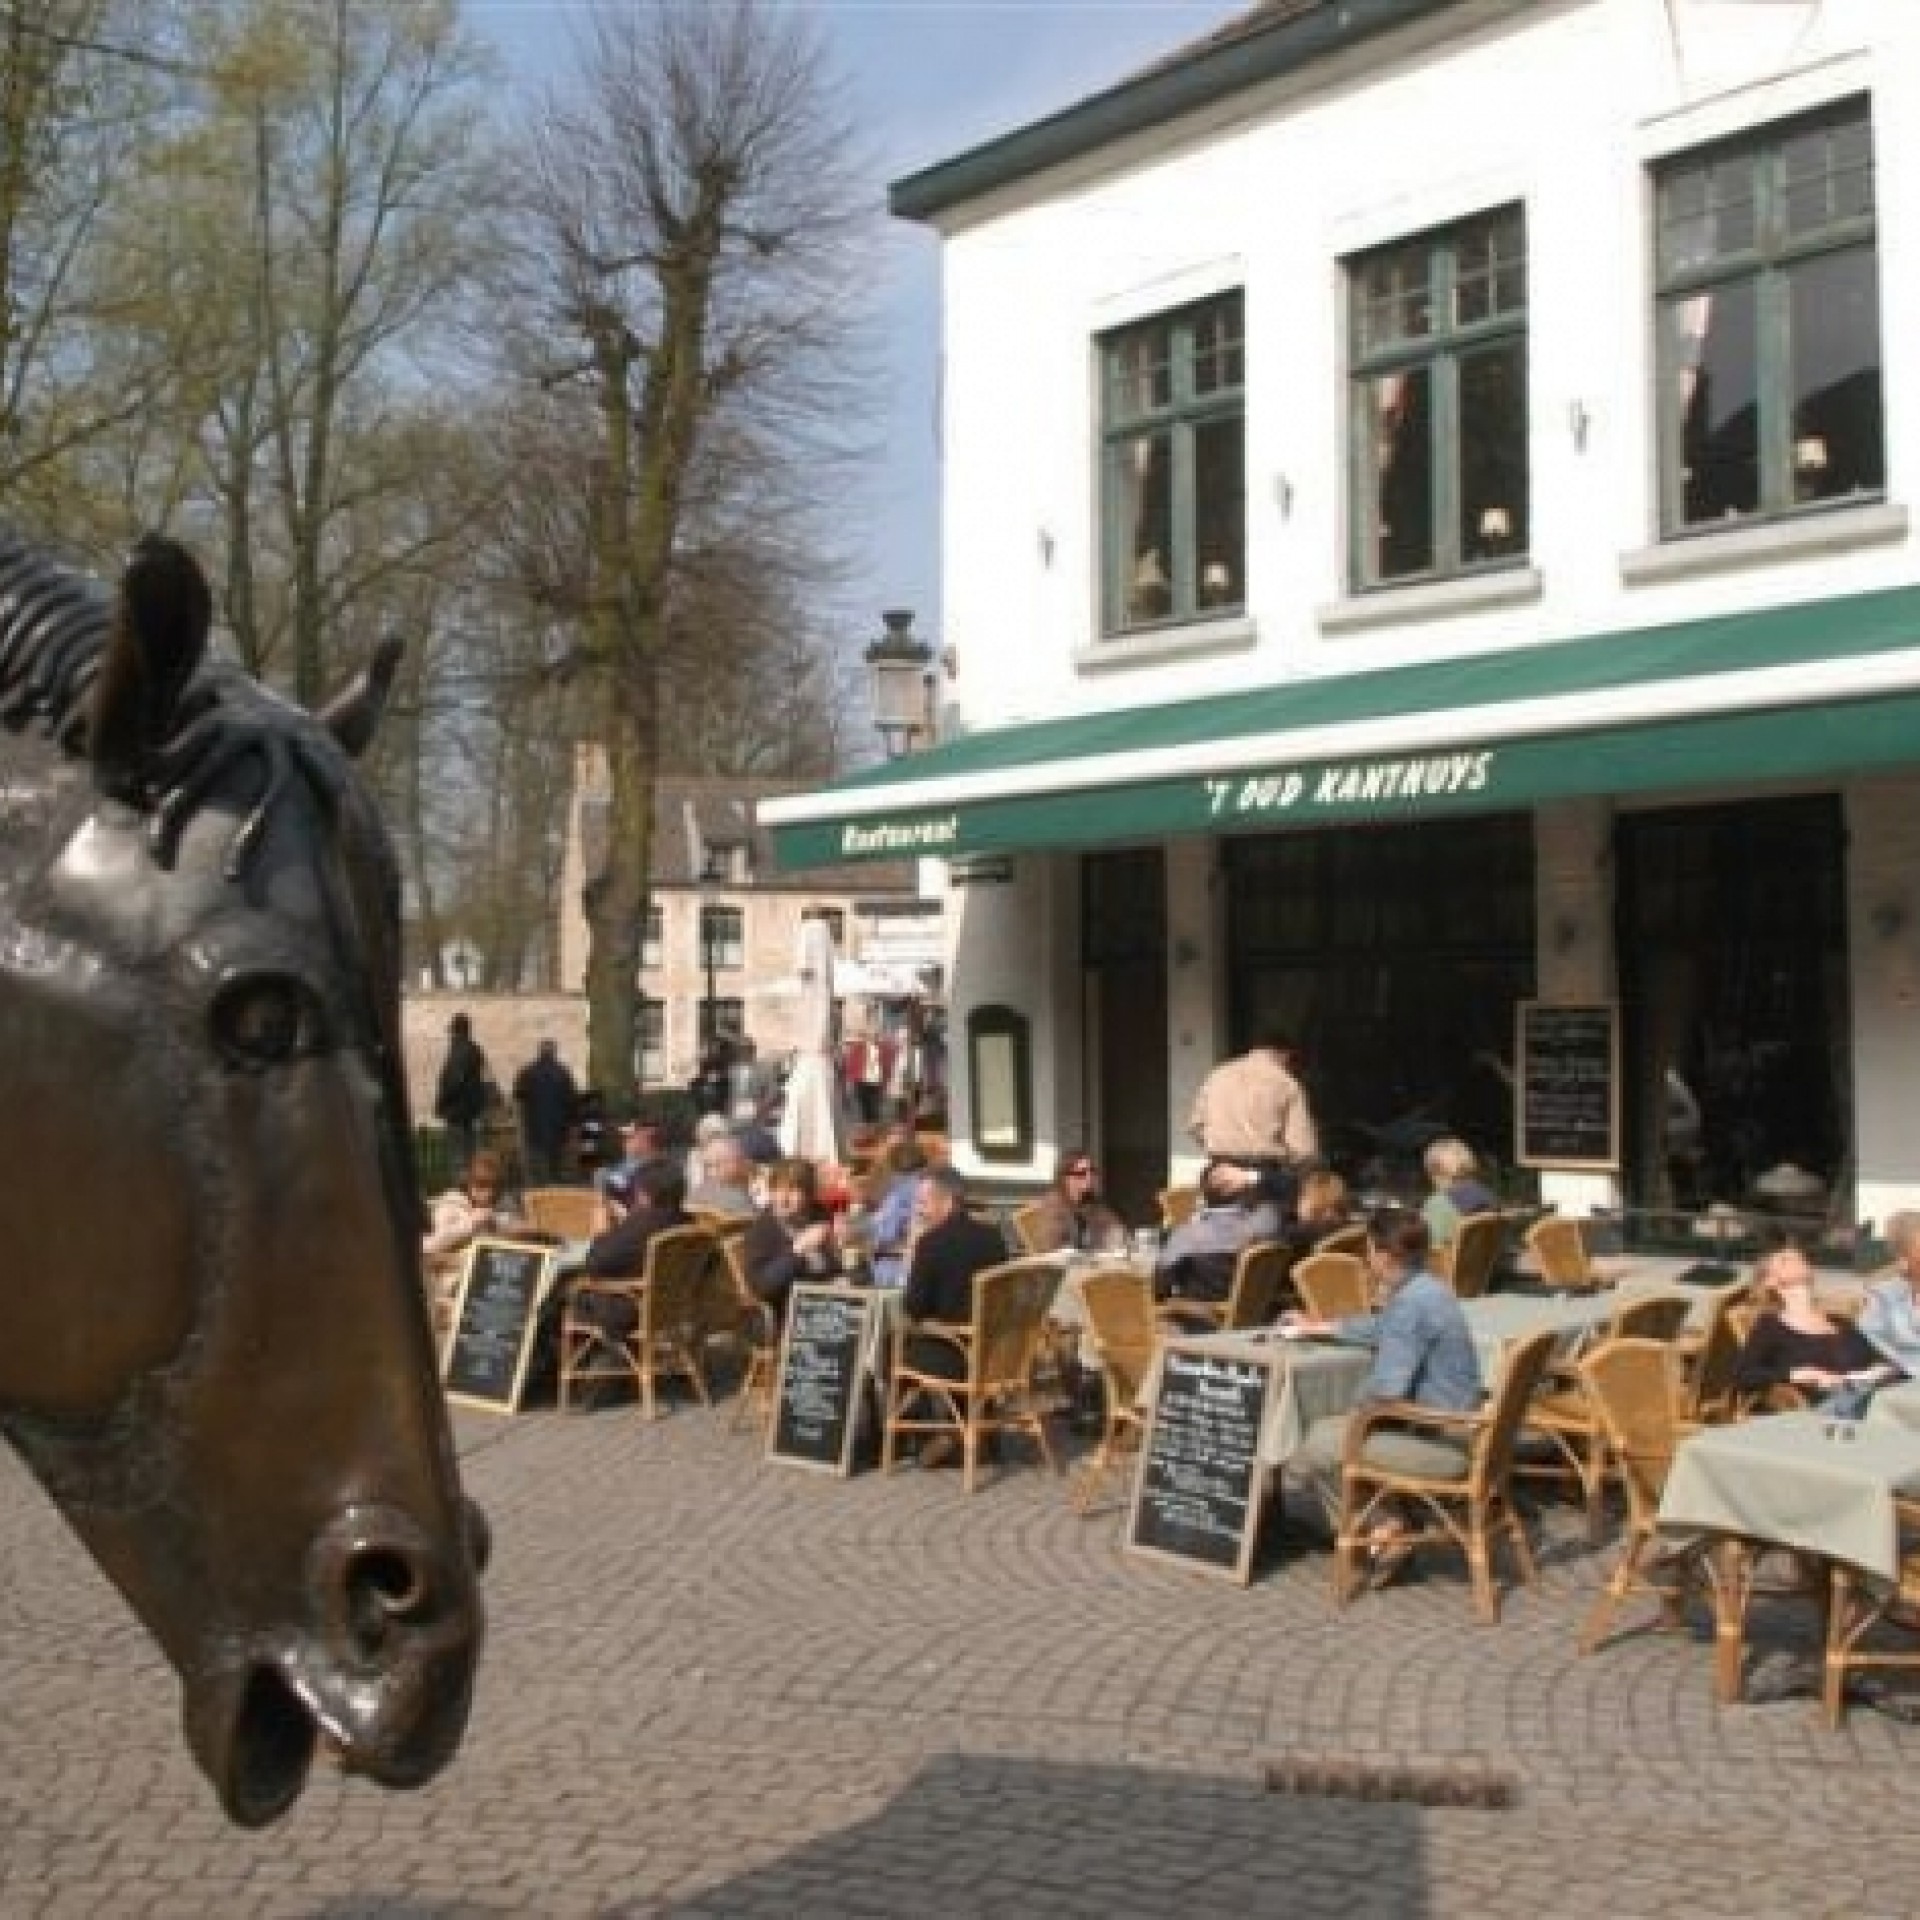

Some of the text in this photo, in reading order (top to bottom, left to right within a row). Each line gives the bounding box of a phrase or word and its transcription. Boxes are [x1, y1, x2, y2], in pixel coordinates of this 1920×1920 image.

[1237, 772, 1303, 811] OUD
[1312, 751, 1494, 806] KANTHUYS
[841, 812, 958, 855] Restaurant
